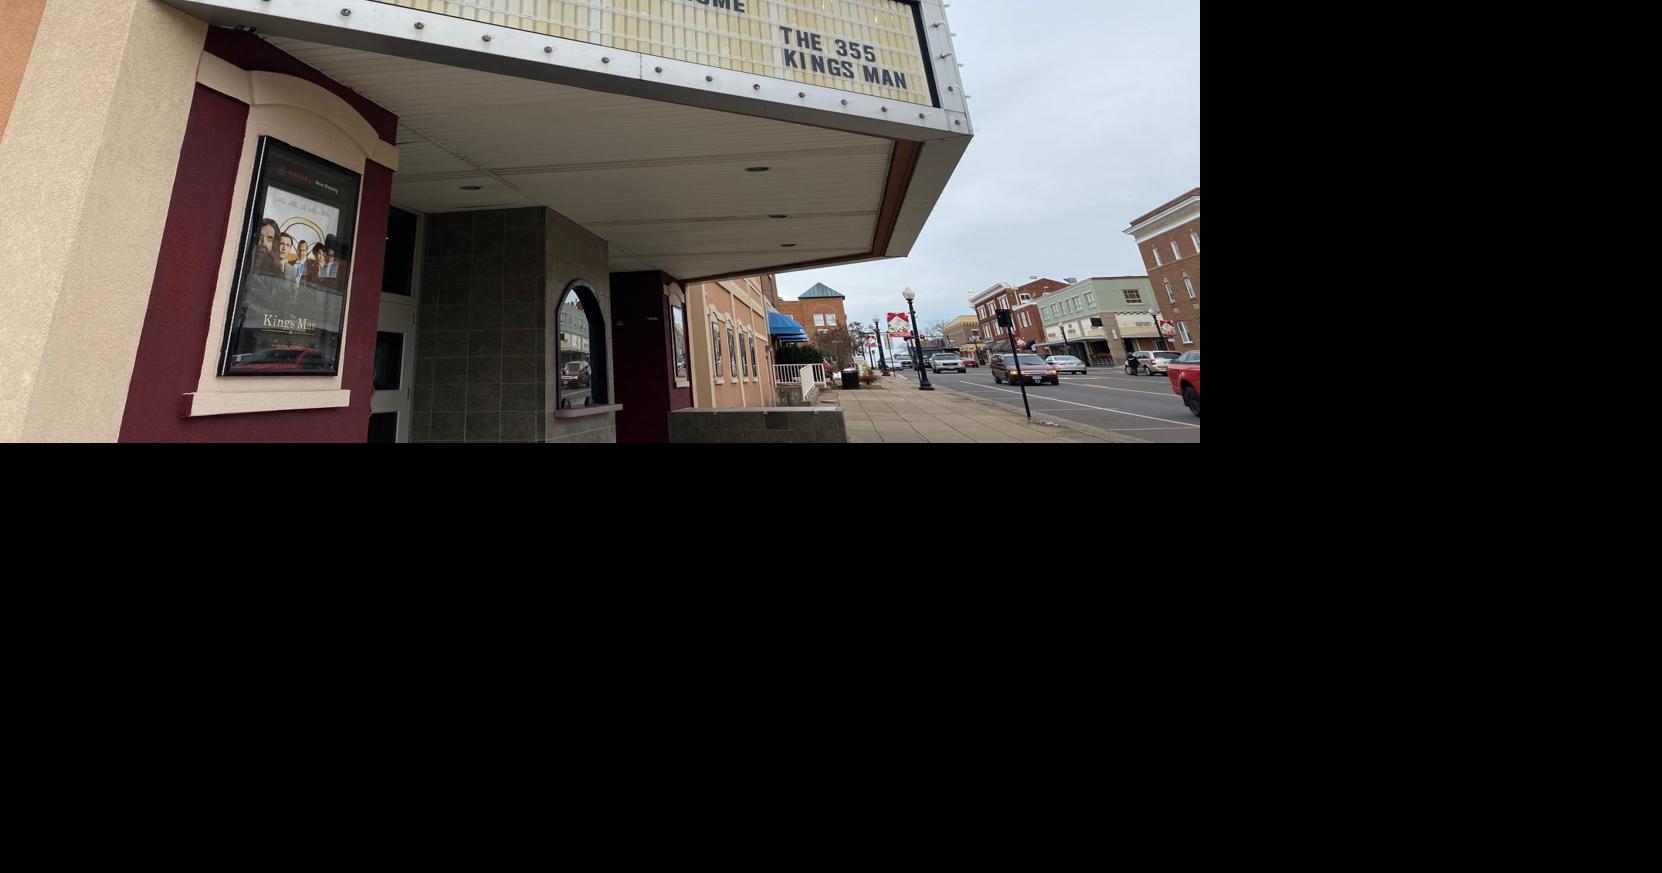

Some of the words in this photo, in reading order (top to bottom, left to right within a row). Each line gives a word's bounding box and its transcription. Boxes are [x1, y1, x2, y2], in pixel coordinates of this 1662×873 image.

[688, 0, 745, 13] ME
[779, 26, 822, 52] THE
[834, 38, 876, 63] 355
[783, 48, 855, 79] KINGS
[862, 65, 908, 89] MAN
